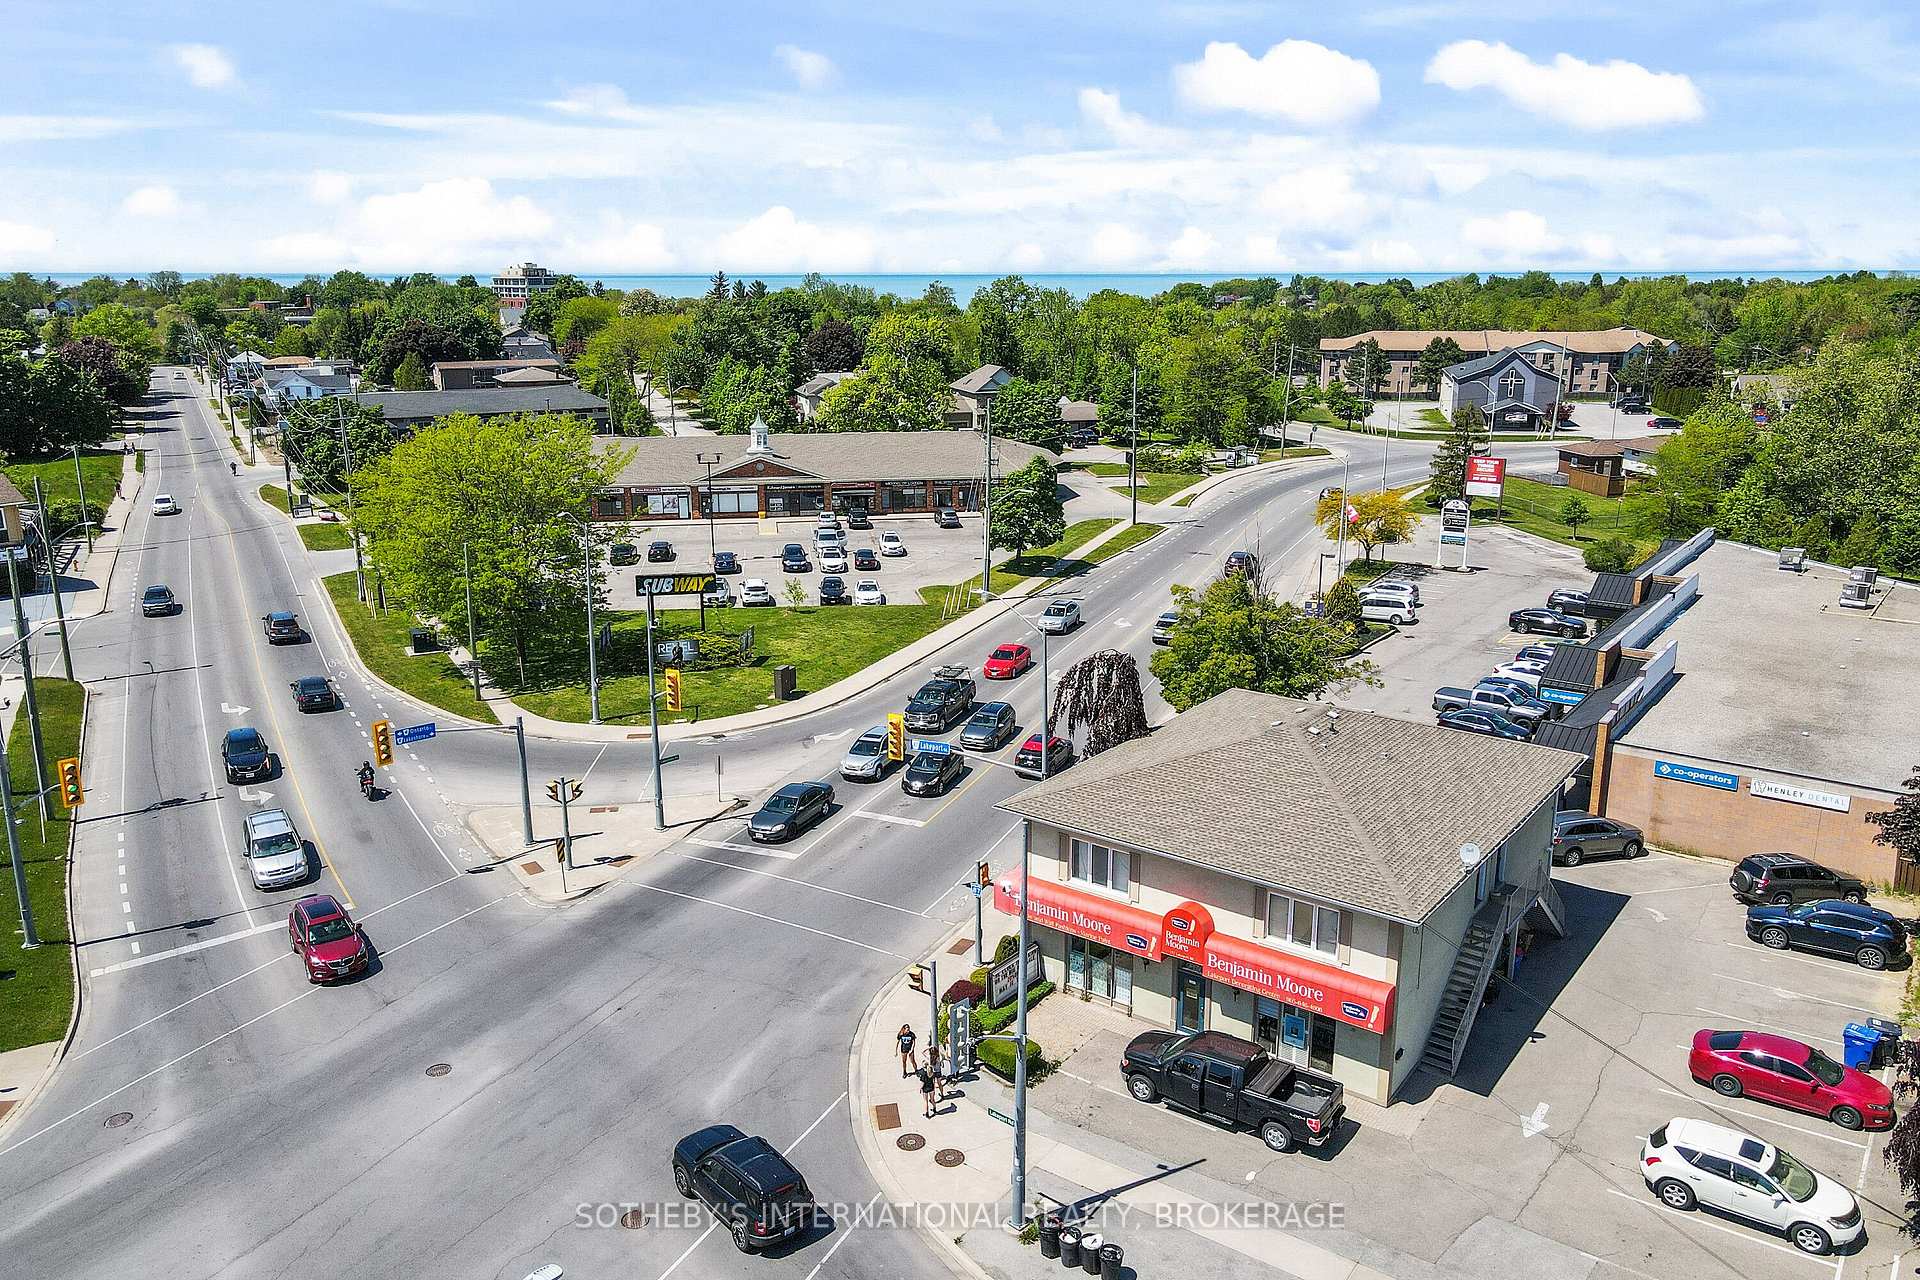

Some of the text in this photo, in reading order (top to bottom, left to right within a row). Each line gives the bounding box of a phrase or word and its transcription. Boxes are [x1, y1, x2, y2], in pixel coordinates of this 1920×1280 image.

[639, 575, 715, 594] SUBWAY
[920, 741, 943, 753] Lakeport
[1673, 767, 1733, 786] co-operators
[1766, 785, 1846, 807] HENLEY DENTAL
[1014, 895, 1069, 922] Bnjamin
[1072, 911, 1112, 935] Moore
[1166, 930, 1201, 948] Benjamin
[1166, 939, 1189, 952] Moore
[1207, 952, 1324, 1002] Benjamin Moore
[1207, 970, 1230, 984] Lakeport
[1231, 978, 1261, 994] Decorating
[989, 1108, 1008, 1123] Lakeport
